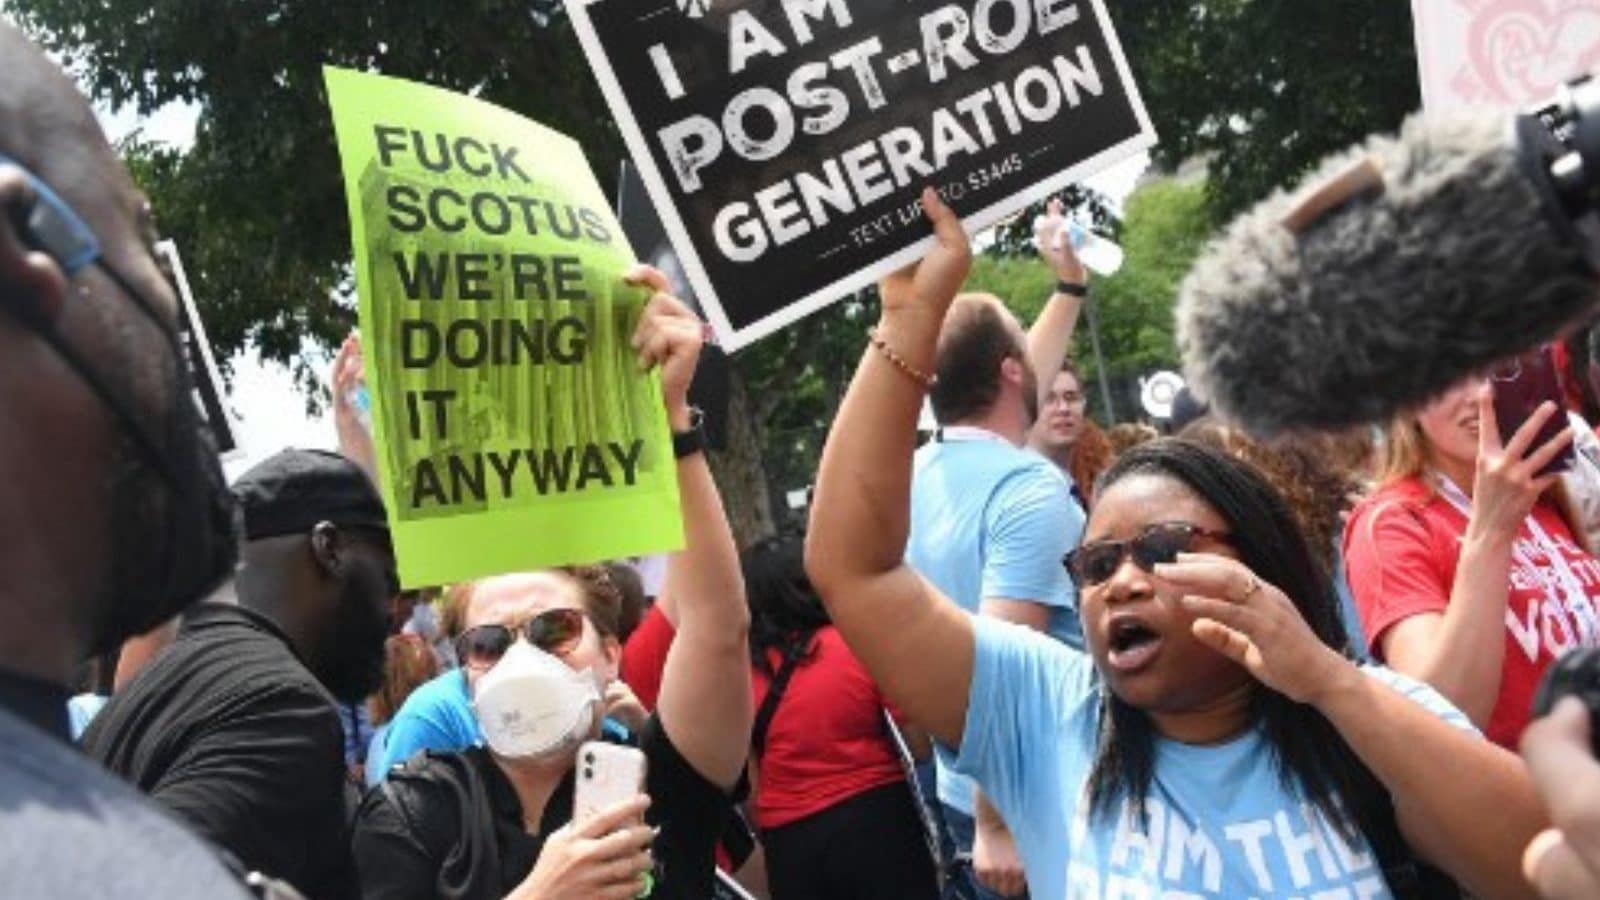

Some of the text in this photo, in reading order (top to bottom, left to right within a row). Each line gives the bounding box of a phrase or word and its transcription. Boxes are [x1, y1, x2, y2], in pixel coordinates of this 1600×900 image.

[647, 42, 687, 100] I
[374, 125, 531, 183] FUCK
[712, 45, 1104, 263] GENERATION
[387, 186, 612, 244] SCOTUS
[850, 214, 894, 247] TEXT
[395, 253, 586, 301] WE'RE
[401, 319, 587, 369] DOING
[405, 390, 455, 440] IT
[411, 439, 645, 508] ANYWAY
[1111, 796, 1222, 892] AM
